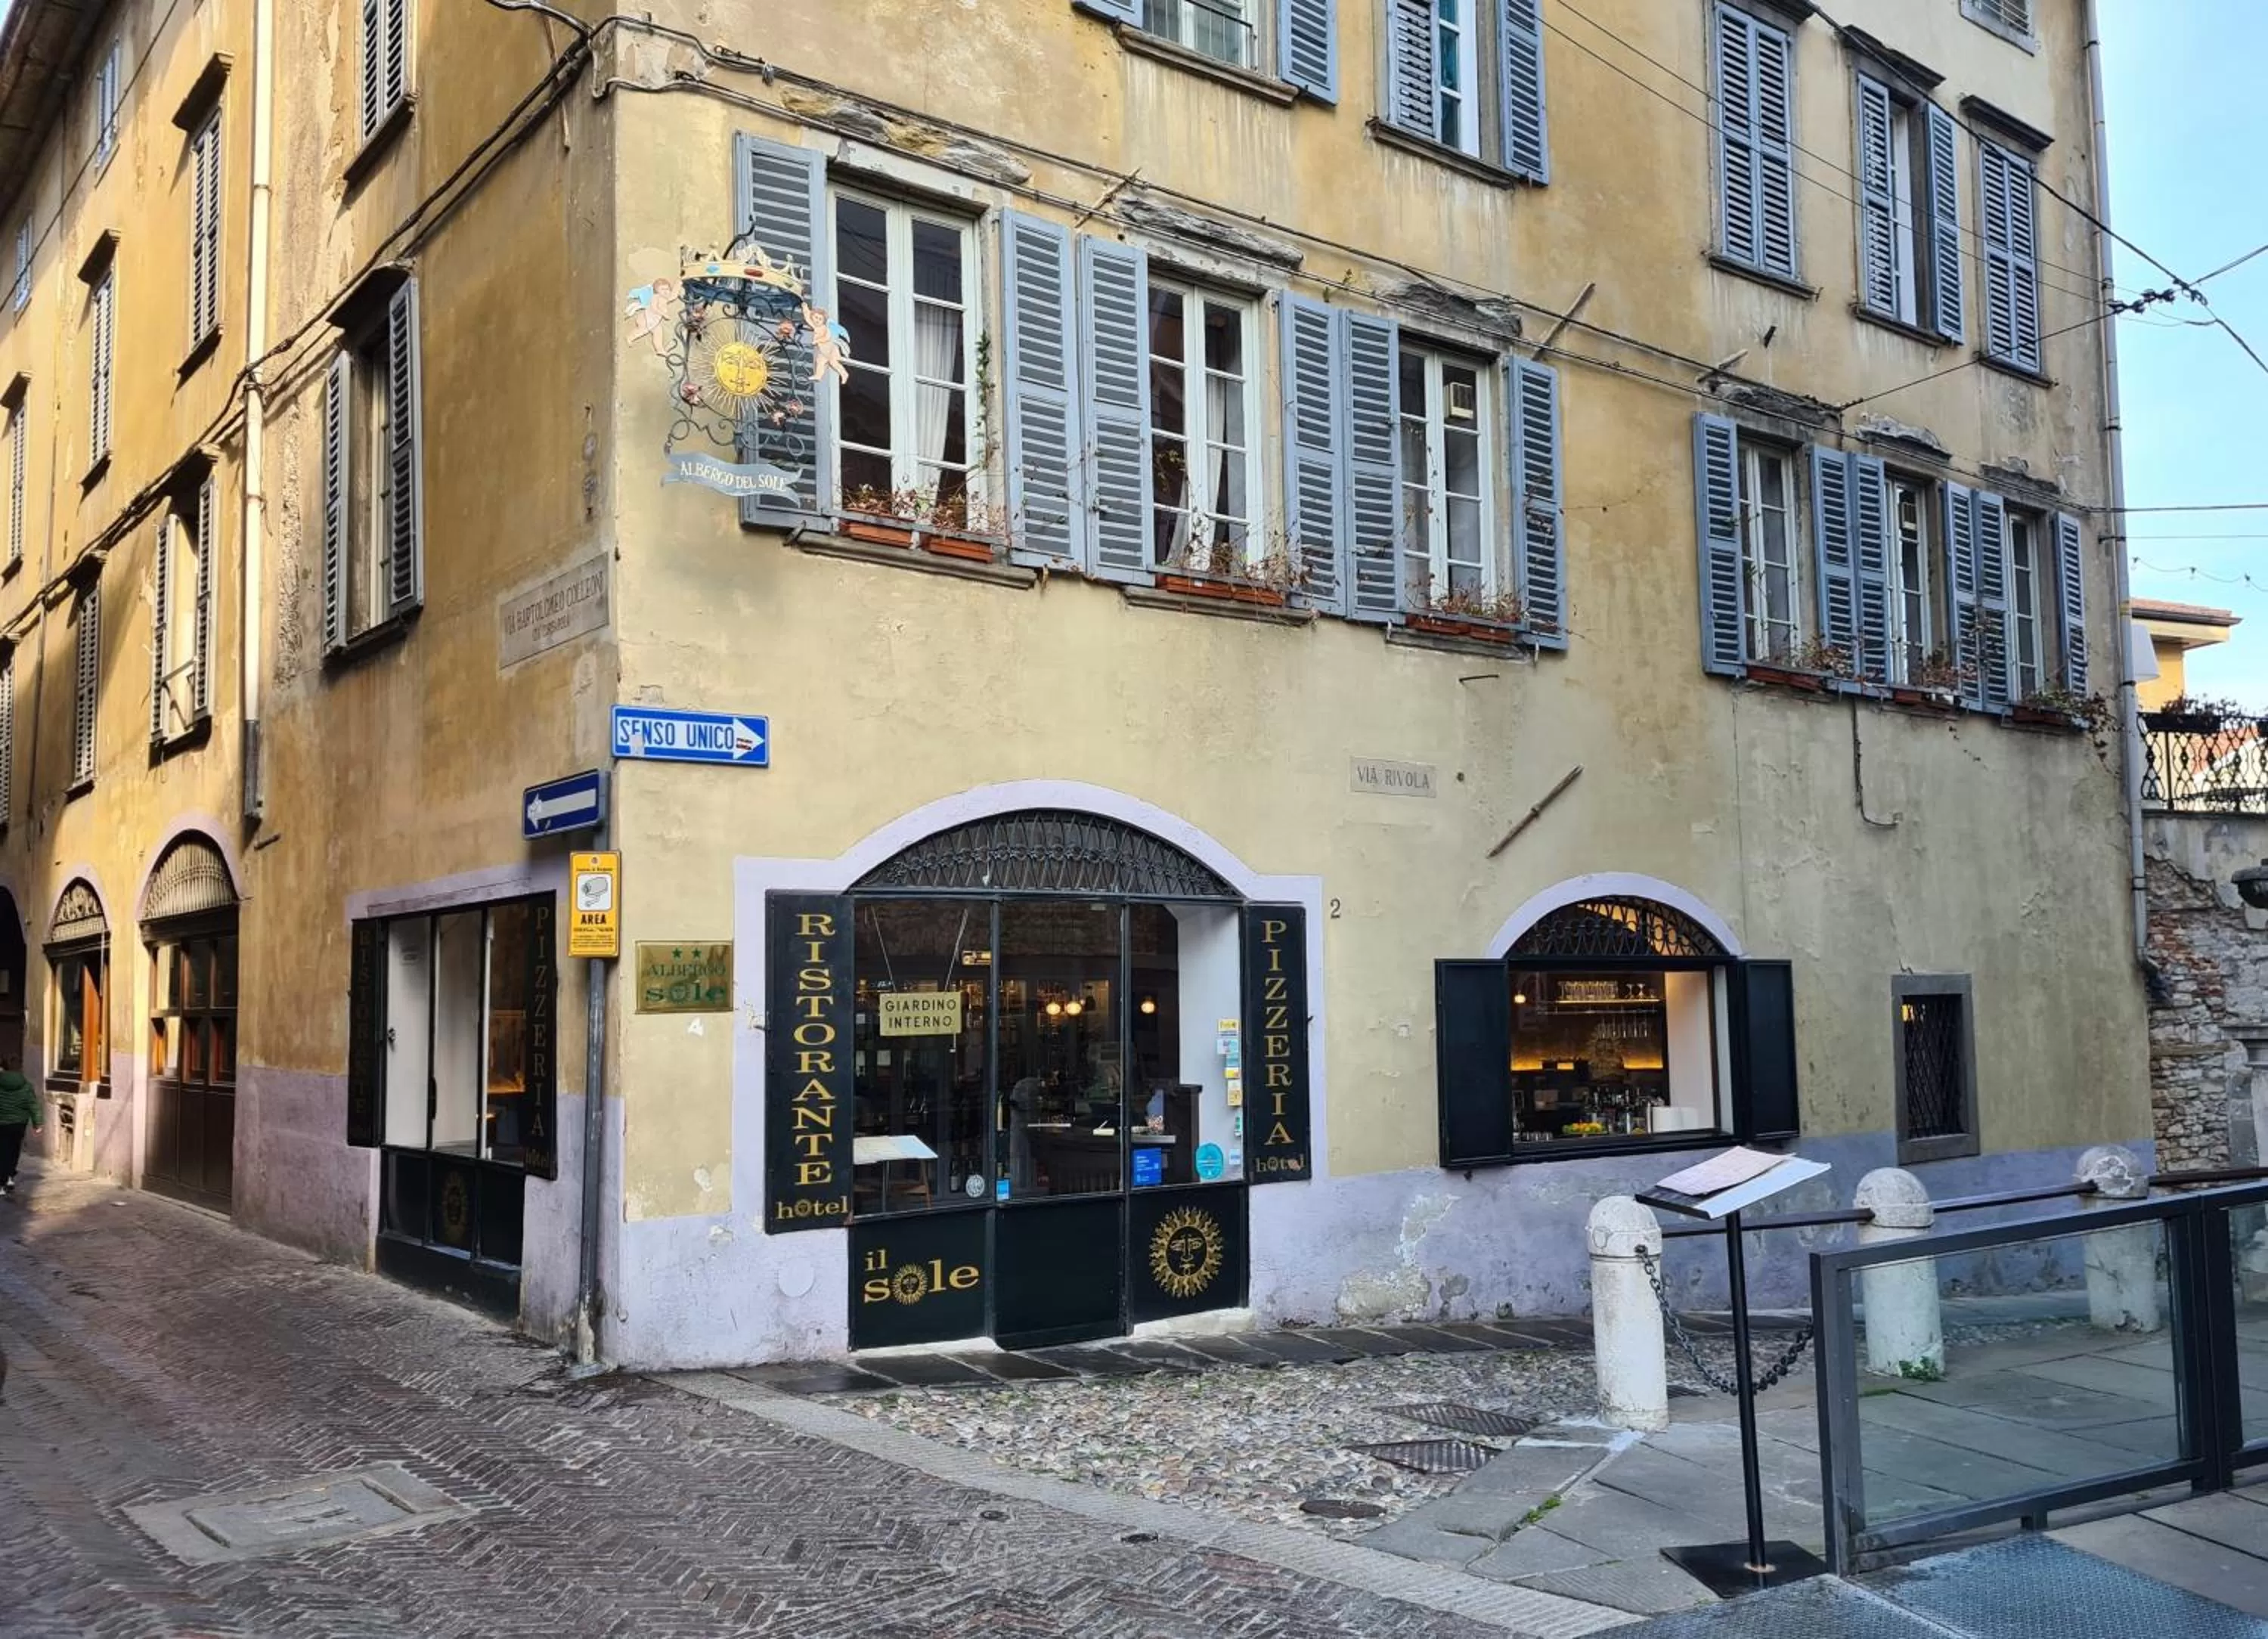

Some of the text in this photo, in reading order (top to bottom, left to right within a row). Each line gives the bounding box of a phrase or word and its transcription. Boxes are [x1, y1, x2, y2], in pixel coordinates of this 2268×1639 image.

[680, 460, 787, 491] ALBERGO DEL SOLE
[686, 723, 734, 750] UNICO
[1357, 764, 1430, 789] VIA RIVOLA
[581, 913, 607, 925] AREA
[1330, 897, 1341, 920] 2
[885, 999, 956, 1012] GIARDINO
[531, 906, 549, 1138] PIZZERIA
[888, 1015, 953, 1029] INTERNO
[1261, 919, 1294, 1146] PIZZERIA
[792, 913, 836, 1186] RISTORANTE
[776, 1195, 848, 1219] hotel
[864, 1249, 888, 1272] il
[863, 1258, 981, 1306] sole
